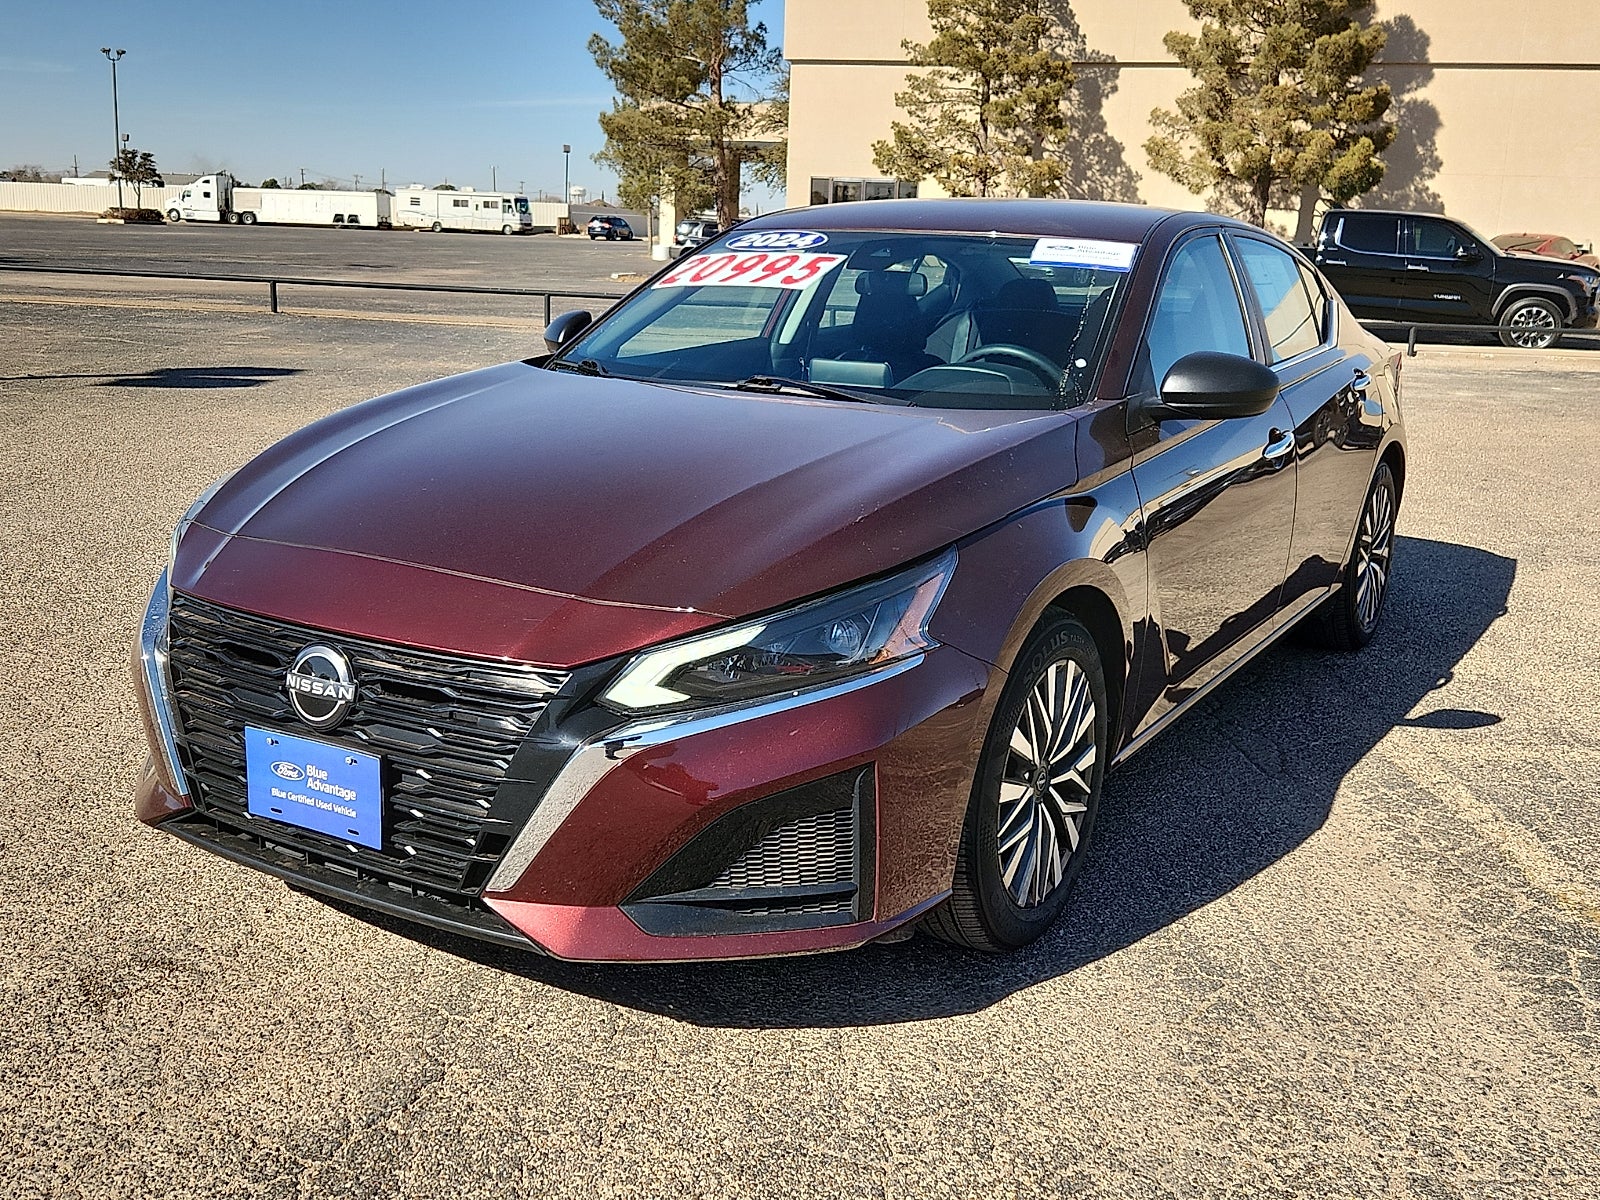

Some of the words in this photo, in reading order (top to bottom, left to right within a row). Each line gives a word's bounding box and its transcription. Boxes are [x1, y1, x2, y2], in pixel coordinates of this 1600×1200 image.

[741, 233, 815, 249] 2024
[659, 254, 838, 285] 20995
[287, 674, 353, 700] NISSAN
[276, 763, 299, 779] Ford
[306, 764, 328, 780] Blue
[306, 777, 357, 800] Advantage
[271, 788, 287, 799] Blue
[287, 791, 315, 806] Certified
[316, 799, 333, 811] Used
[333, 804, 357, 818] Vehicle
